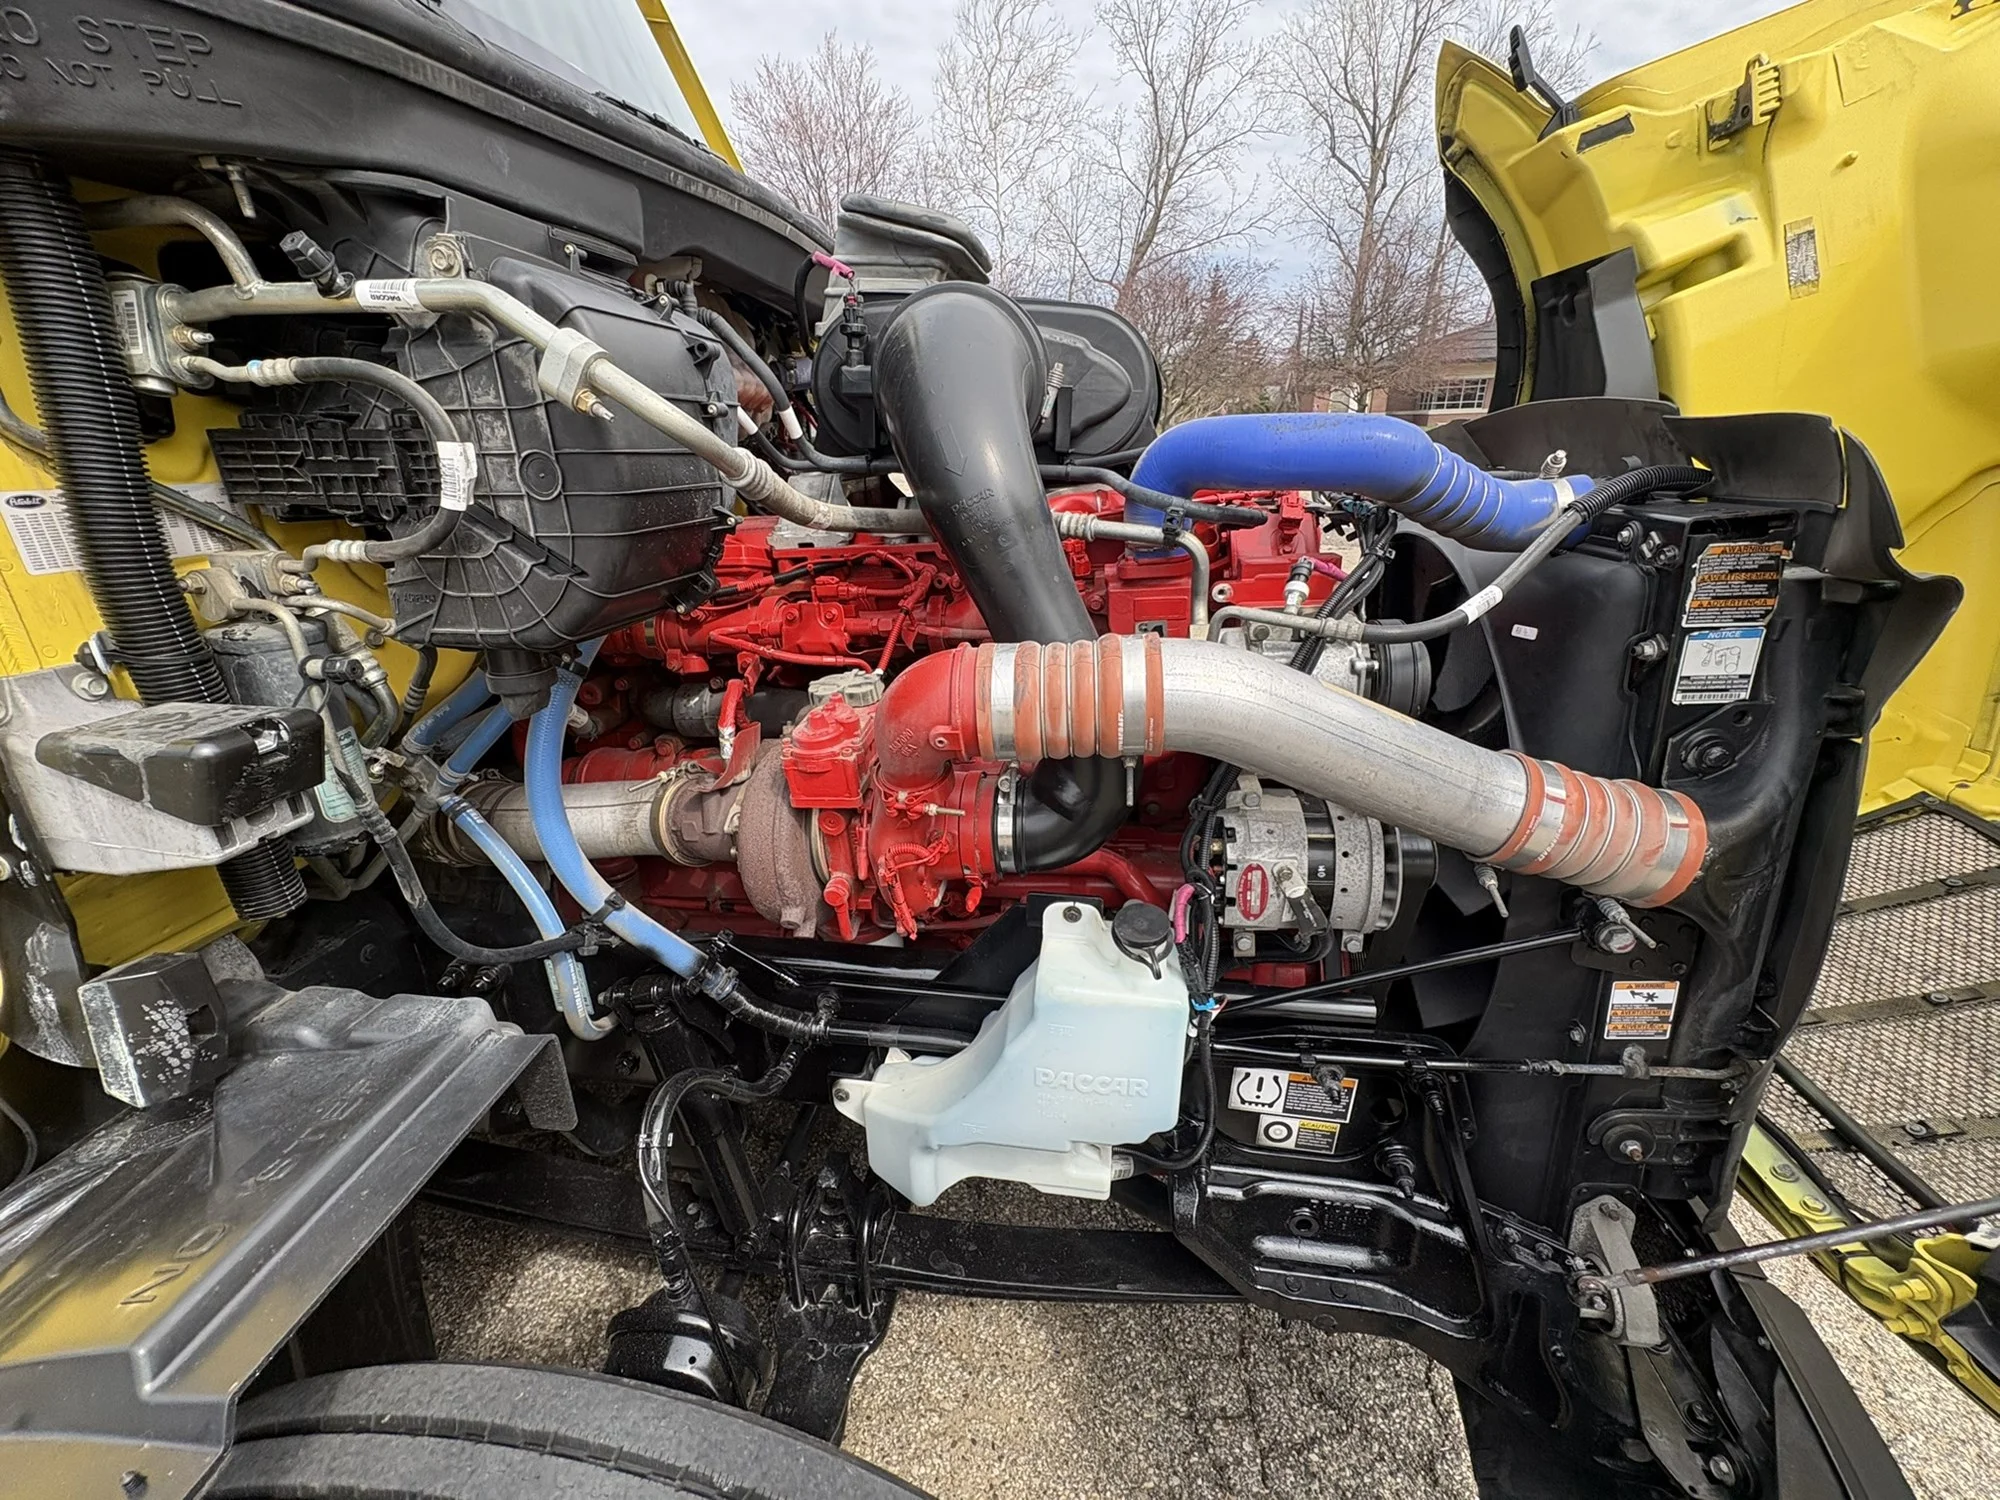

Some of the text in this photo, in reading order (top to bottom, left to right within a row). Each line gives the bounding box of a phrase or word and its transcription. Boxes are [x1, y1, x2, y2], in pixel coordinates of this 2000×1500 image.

[0, 6, 213, 67] O STEP
[44, 57, 115, 90] NOT
[139, 67, 243, 107] PULL
[1726, 545, 1771, 554] WARNING
[1034, 1067, 1149, 1097] PACCAR
